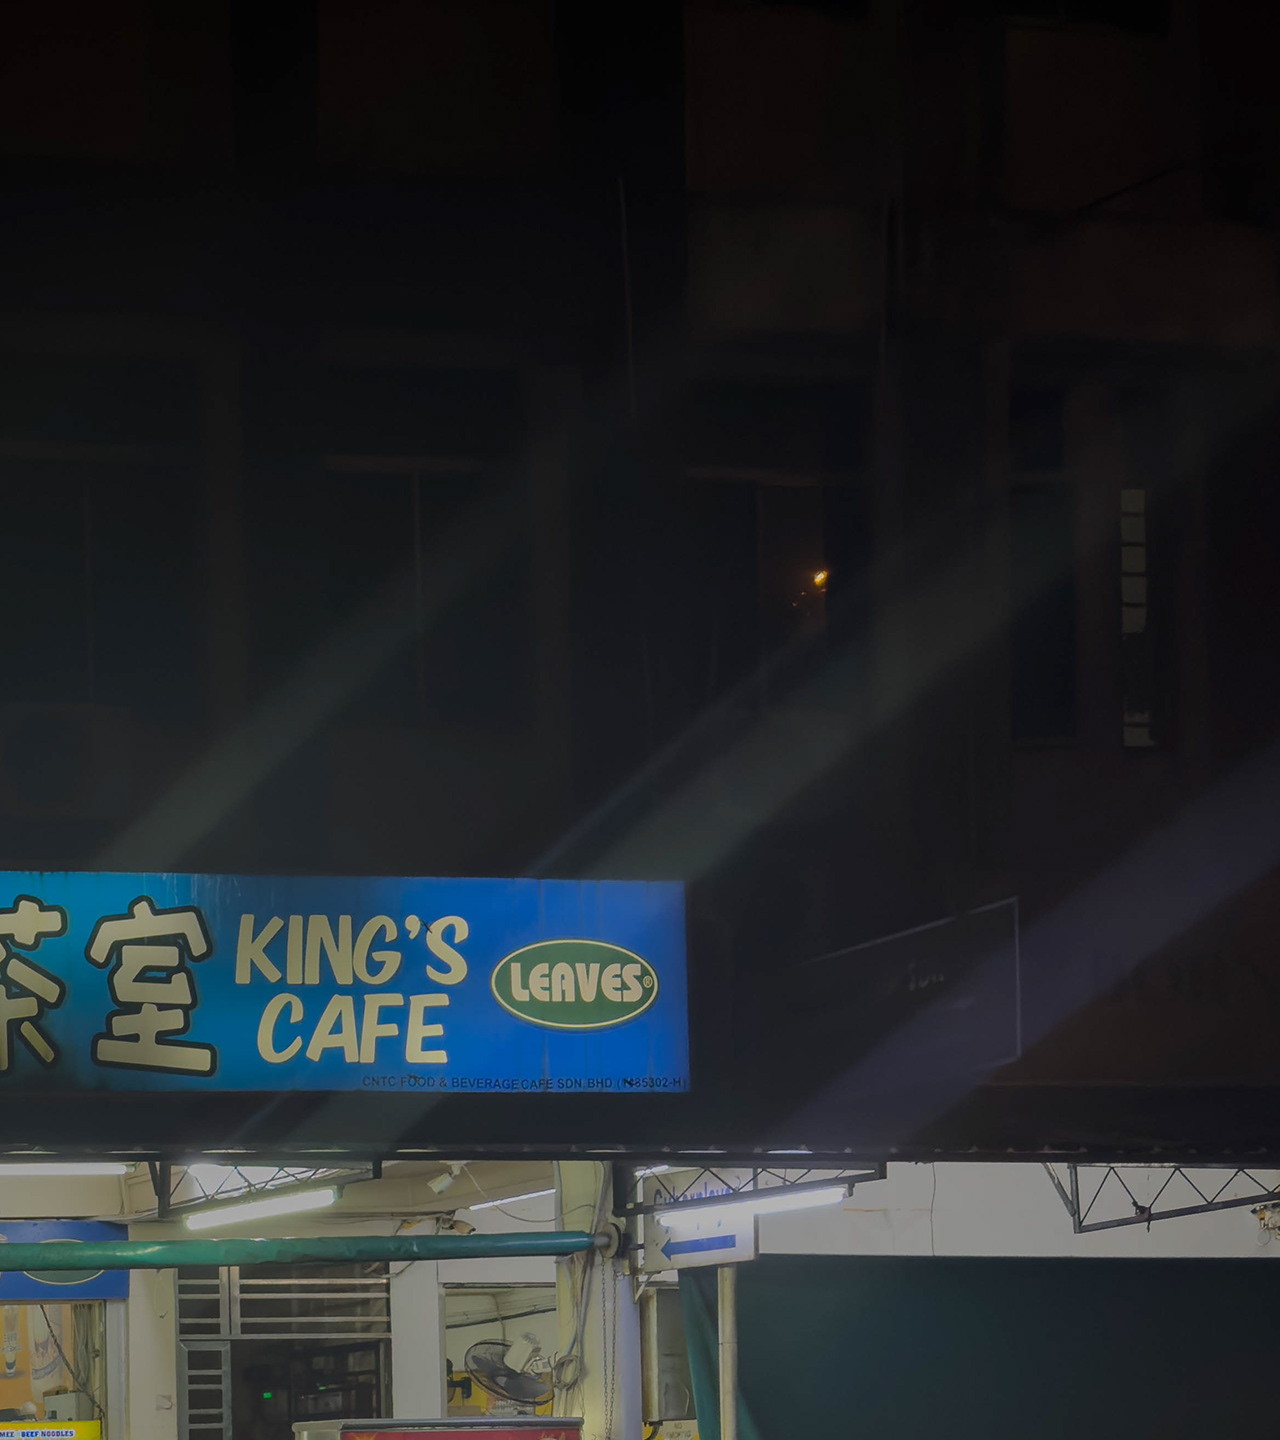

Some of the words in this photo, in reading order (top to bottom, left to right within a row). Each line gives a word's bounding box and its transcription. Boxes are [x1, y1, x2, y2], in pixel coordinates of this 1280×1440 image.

[235, 914, 470, 986] KING'S
[257, 993, 450, 1065] CAFE
[400, 1076, 436, 1088] FOOD
[439, 1077, 448, 1088] &
[451, 1077, 520, 1090] BEVERAGE
[520, 1078, 554, 1090] CAFE
